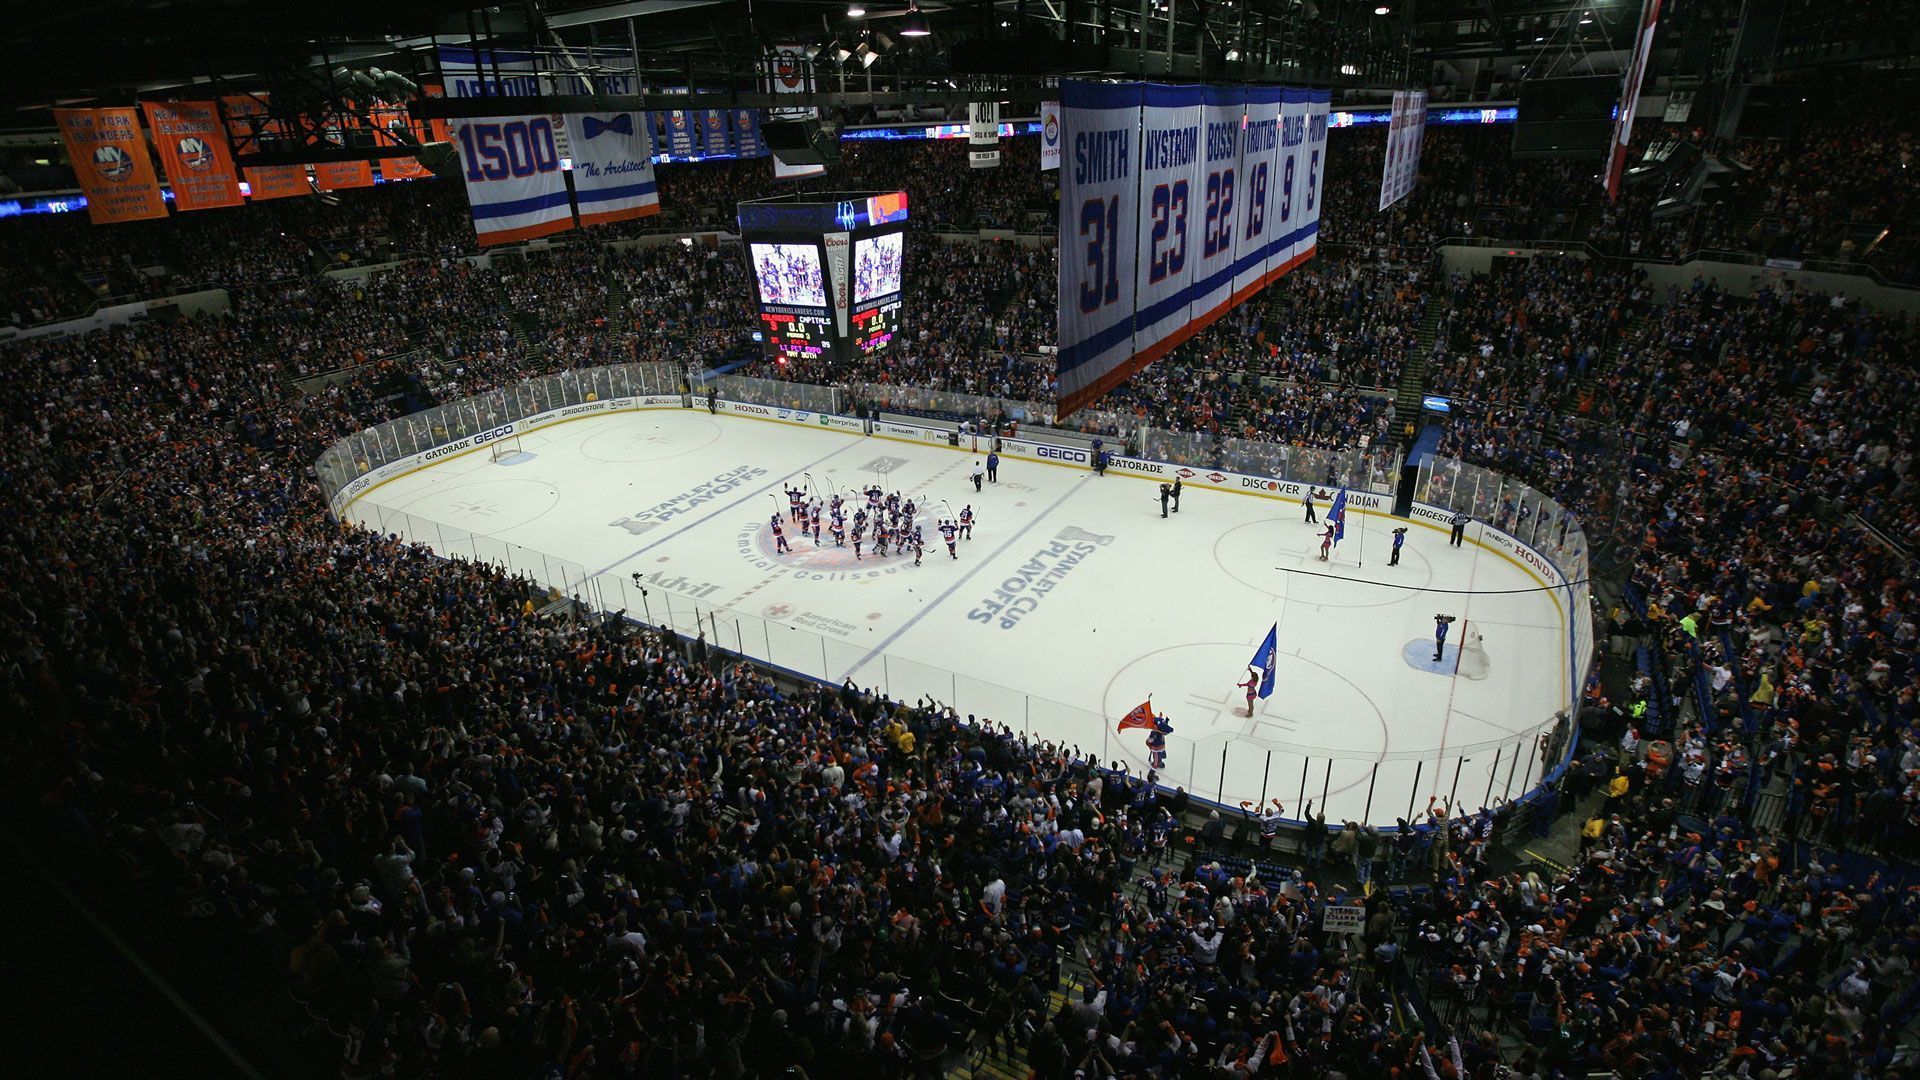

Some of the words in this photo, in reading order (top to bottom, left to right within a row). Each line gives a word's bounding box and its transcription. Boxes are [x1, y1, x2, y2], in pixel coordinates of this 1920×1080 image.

[67, 116, 94, 129] NEW
[101, 115, 130, 127] YORK
[153, 109, 178, 121] NEW
[181, 108, 212, 120] YORK
[73, 129, 134, 142] ISLANDERS
[159, 122, 216, 134] ISLANDERS
[1246, 118, 1278, 154] TROTTIER
[1281, 115, 1305, 148] GILLIES
[1309, 114, 1326, 144] POTVIN
[458, 116, 560, 182] 1500
[1144, 126, 1198, 170] NYSTROM
[1206, 120, 1240, 162] BOSSY
[1075, 128, 1129, 186] SMITH
[1281, 155, 1295, 223] 9
[1306, 150, 1319, 212] 5
[1246, 161, 1268, 241] 19
[1203, 168, 1234, 260] 22
[825, 238, 848, 246] Coors
[1149, 178, 1189, 286] 23
[1080, 194, 1120, 316] 31
[836, 282, 846, 310] Coors
[880, 300, 902, 314] CAPITALS
[764, 306, 825, 316] NEWYORKISLANDERS.COM
[800, 316, 832, 325] CAPITALS
[871, 313, 884, 326] 0.0
[892, 309, 896, 320] 1
[788, 322, 806, 332] 0.0
[818, 324, 824, 334] 1
[562, 402, 605, 416] BRIDGESTONE
[652, 396, 670, 405] Coors
[695, 399, 726, 410] DISCVER
[734, 404, 770, 416] HONDA
[529, 414, 556, 424] McDonald's
[474, 424, 514, 446] GEICO
[425, 440, 470, 460] GATORADE
[1006, 440, 1026, 454] Morgan
[1036, 446, 1086, 462] GEICO
[1108, 458, 1164, 474] GATORADE
[348, 478, 370, 500] jetBlue
[635, 478, 714, 521] STANLEY
[714, 465, 750, 485] CUP
[654, 467, 768, 524] PLAYOFFS
[1242, 477, 1300, 496] DISCOVER
[1330, 492, 1380, 508] CNADIAN
[738, 522, 778, 572] Memorial
[793, 562, 918, 582] Coliseum
[1030, 542, 1096, 598] STANLEY
[1514, 544, 1555, 584] HONDA
[646, 570, 721, 598] Advil
[967, 540, 1070, 624] PLAYOFFS
[802, 610, 857, 631] American
[1000, 594, 1038, 630] CUP
[793, 616, 818, 629] Red
[819, 623, 851, 638] Cross
